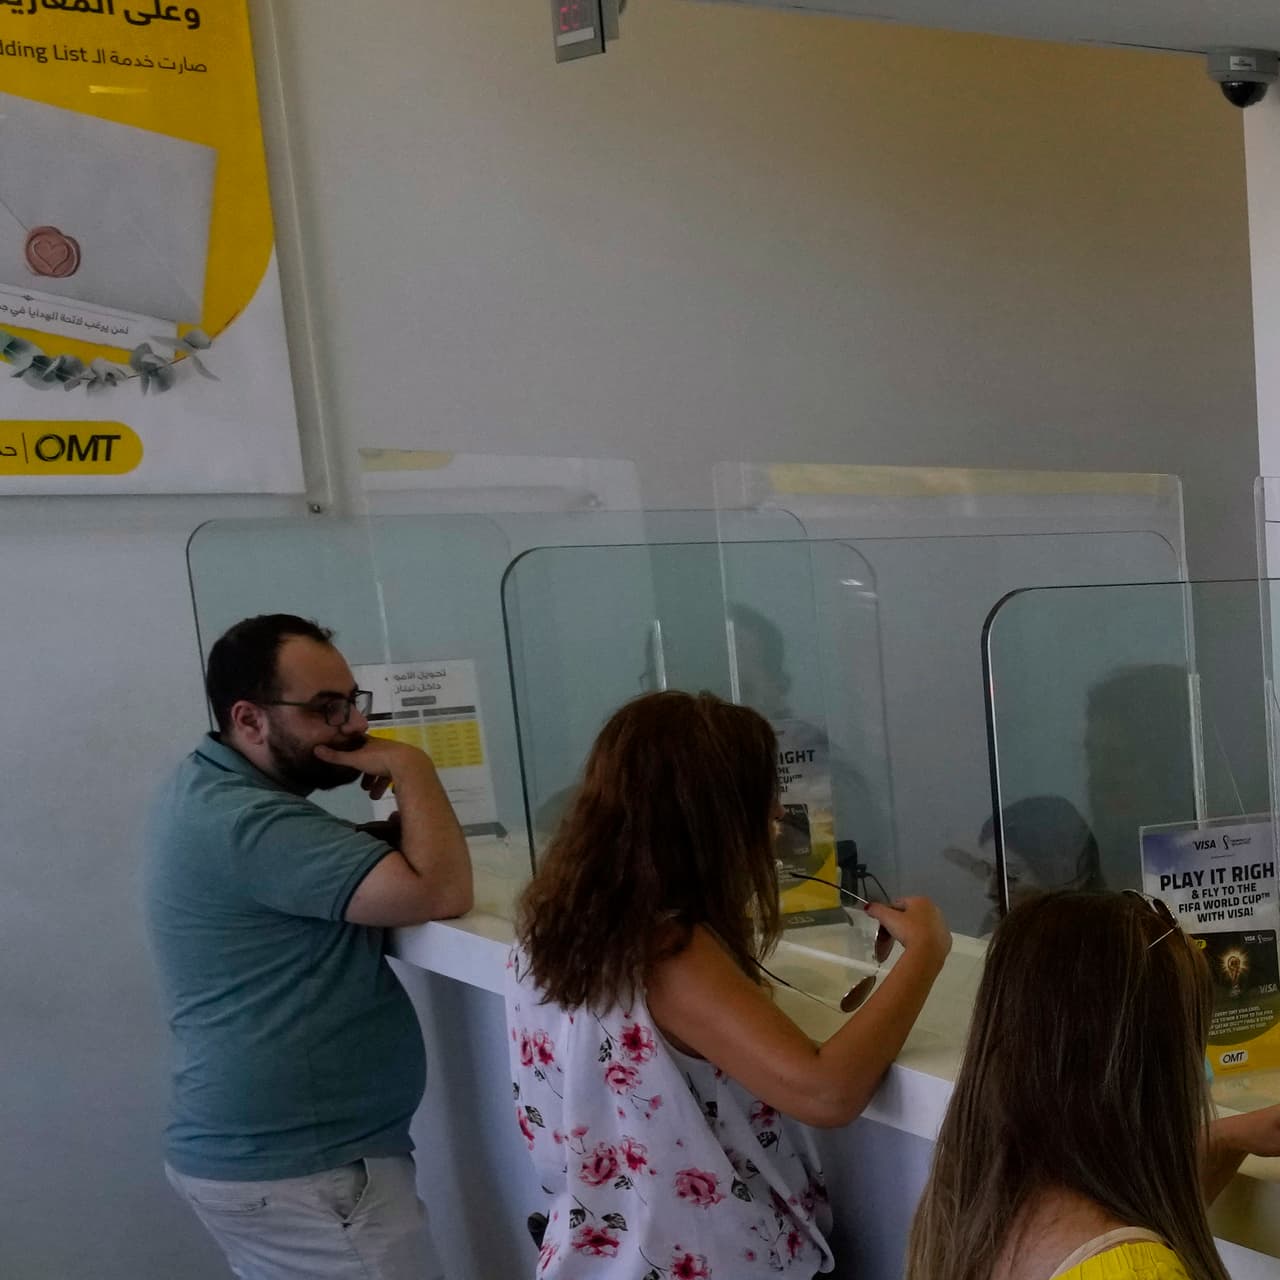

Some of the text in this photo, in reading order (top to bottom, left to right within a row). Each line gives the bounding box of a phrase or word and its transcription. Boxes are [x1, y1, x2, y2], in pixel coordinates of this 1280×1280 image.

[124, 0, 201, 30] وعلى
[53, 44, 88, 63] List
[109, 50, 155, 69] خدمة
[157, 56, 208, 74] صارت
[34, 433, 121, 462] OMT
[776, 748, 816, 765] IGHT
[1194, 839, 1217, 851] VISA
[1160, 869, 1204, 891] PLAY
[1210, 868, 1227, 885] IT
[1191, 882, 1257, 900] & FLY TO THE
[1178, 901, 1201, 914] FIFA
[1203, 897, 1240, 910] WORLD
[1197, 906, 1254, 924] WITH VISA!
[1259, 984, 1278, 994] VISA
[1222, 1051, 1245, 1064] OMT
